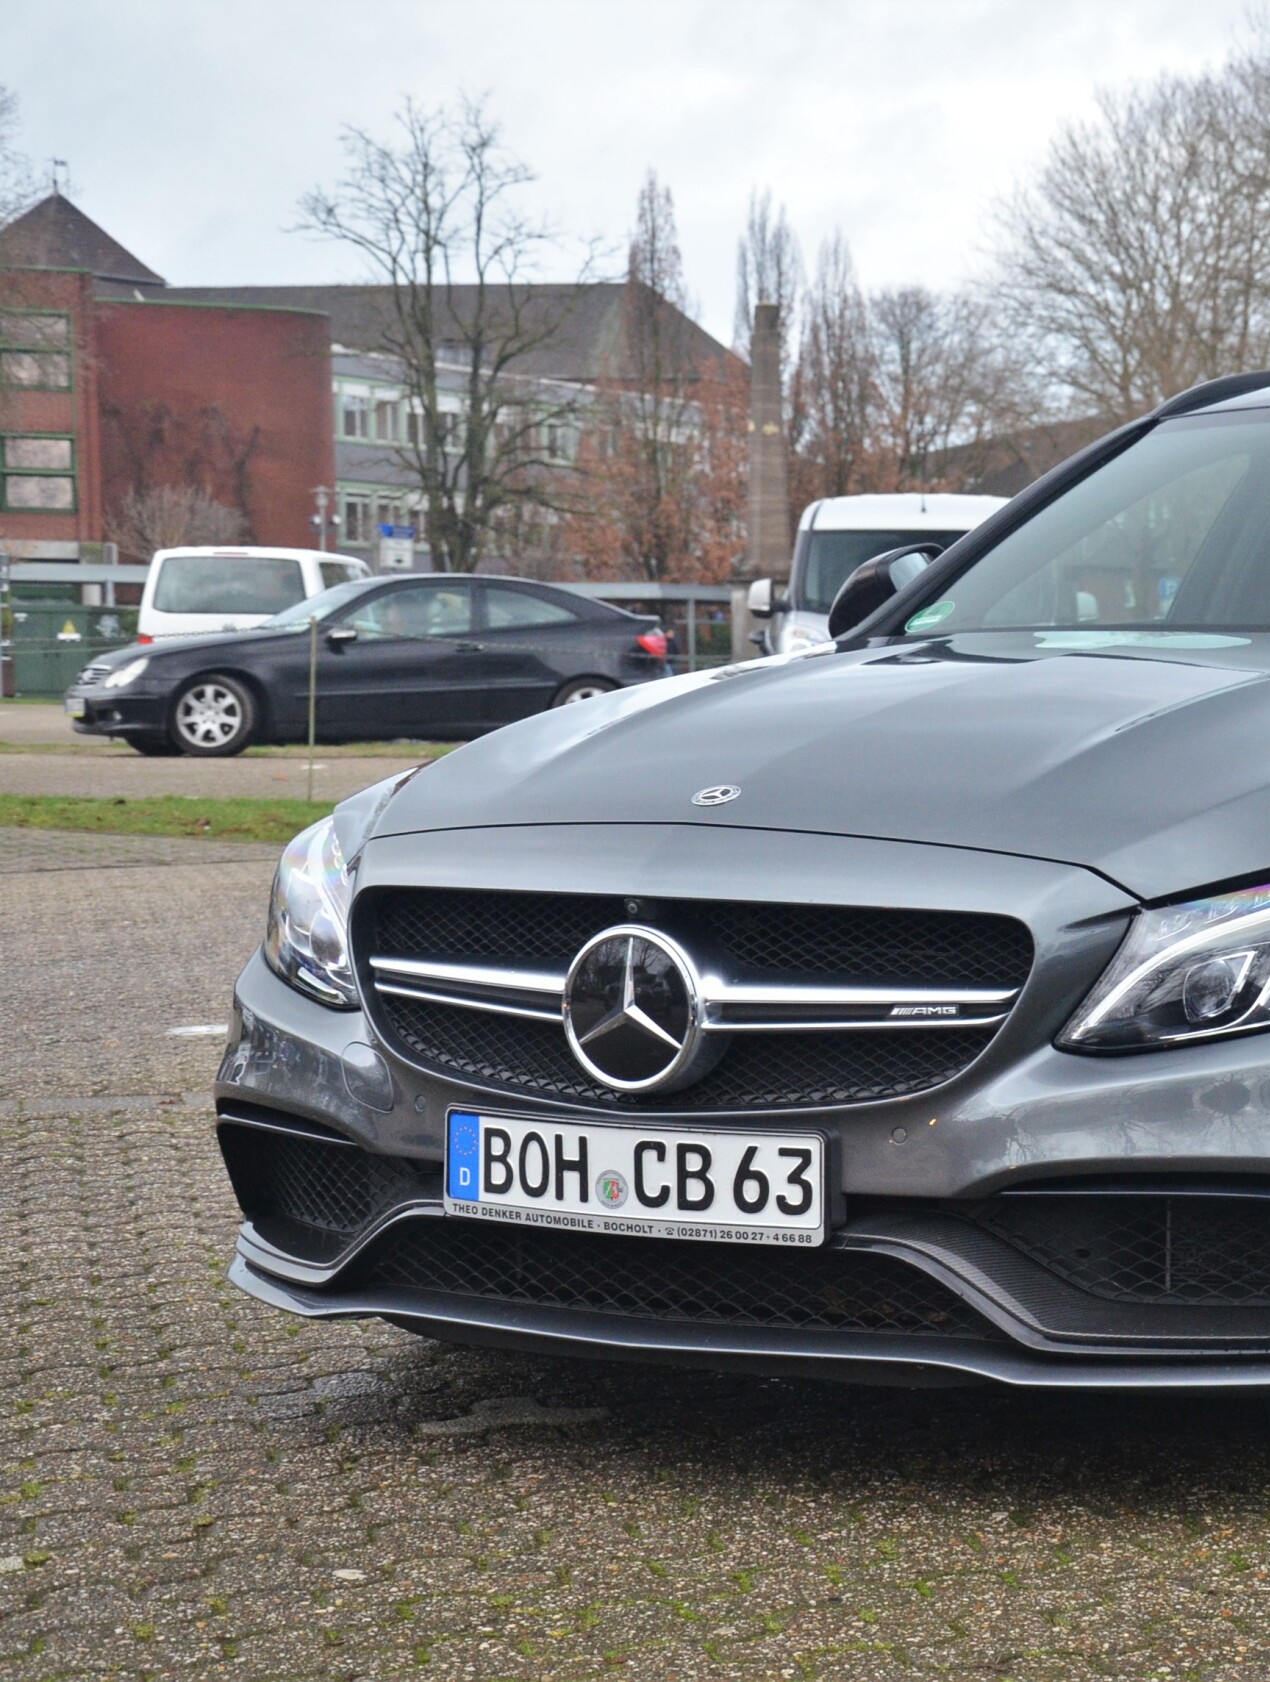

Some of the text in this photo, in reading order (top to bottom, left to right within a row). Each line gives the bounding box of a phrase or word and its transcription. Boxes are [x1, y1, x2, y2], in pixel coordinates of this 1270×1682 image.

[912, 1006, 956, 1014] AMG
[459, 1167, 471, 1187] D
[483, 1126, 590, 1204] BOH
[633, 1140, 717, 1212] CB
[732, 1145, 814, 1217] 63
[452, 1203, 479, 1215] THEO
[482, 1207, 522, 1221] DENKER
[524, 1213, 594, 1230] AUTOMOBILE
[603, 1221, 654, 1235] BOCHOLT
[677, 1228, 718, 1240] (02871)
[719, 1230, 733, 1240] 26
[735, 1231, 749, 1241] 00
[751, 1231, 765, 1242] 27
